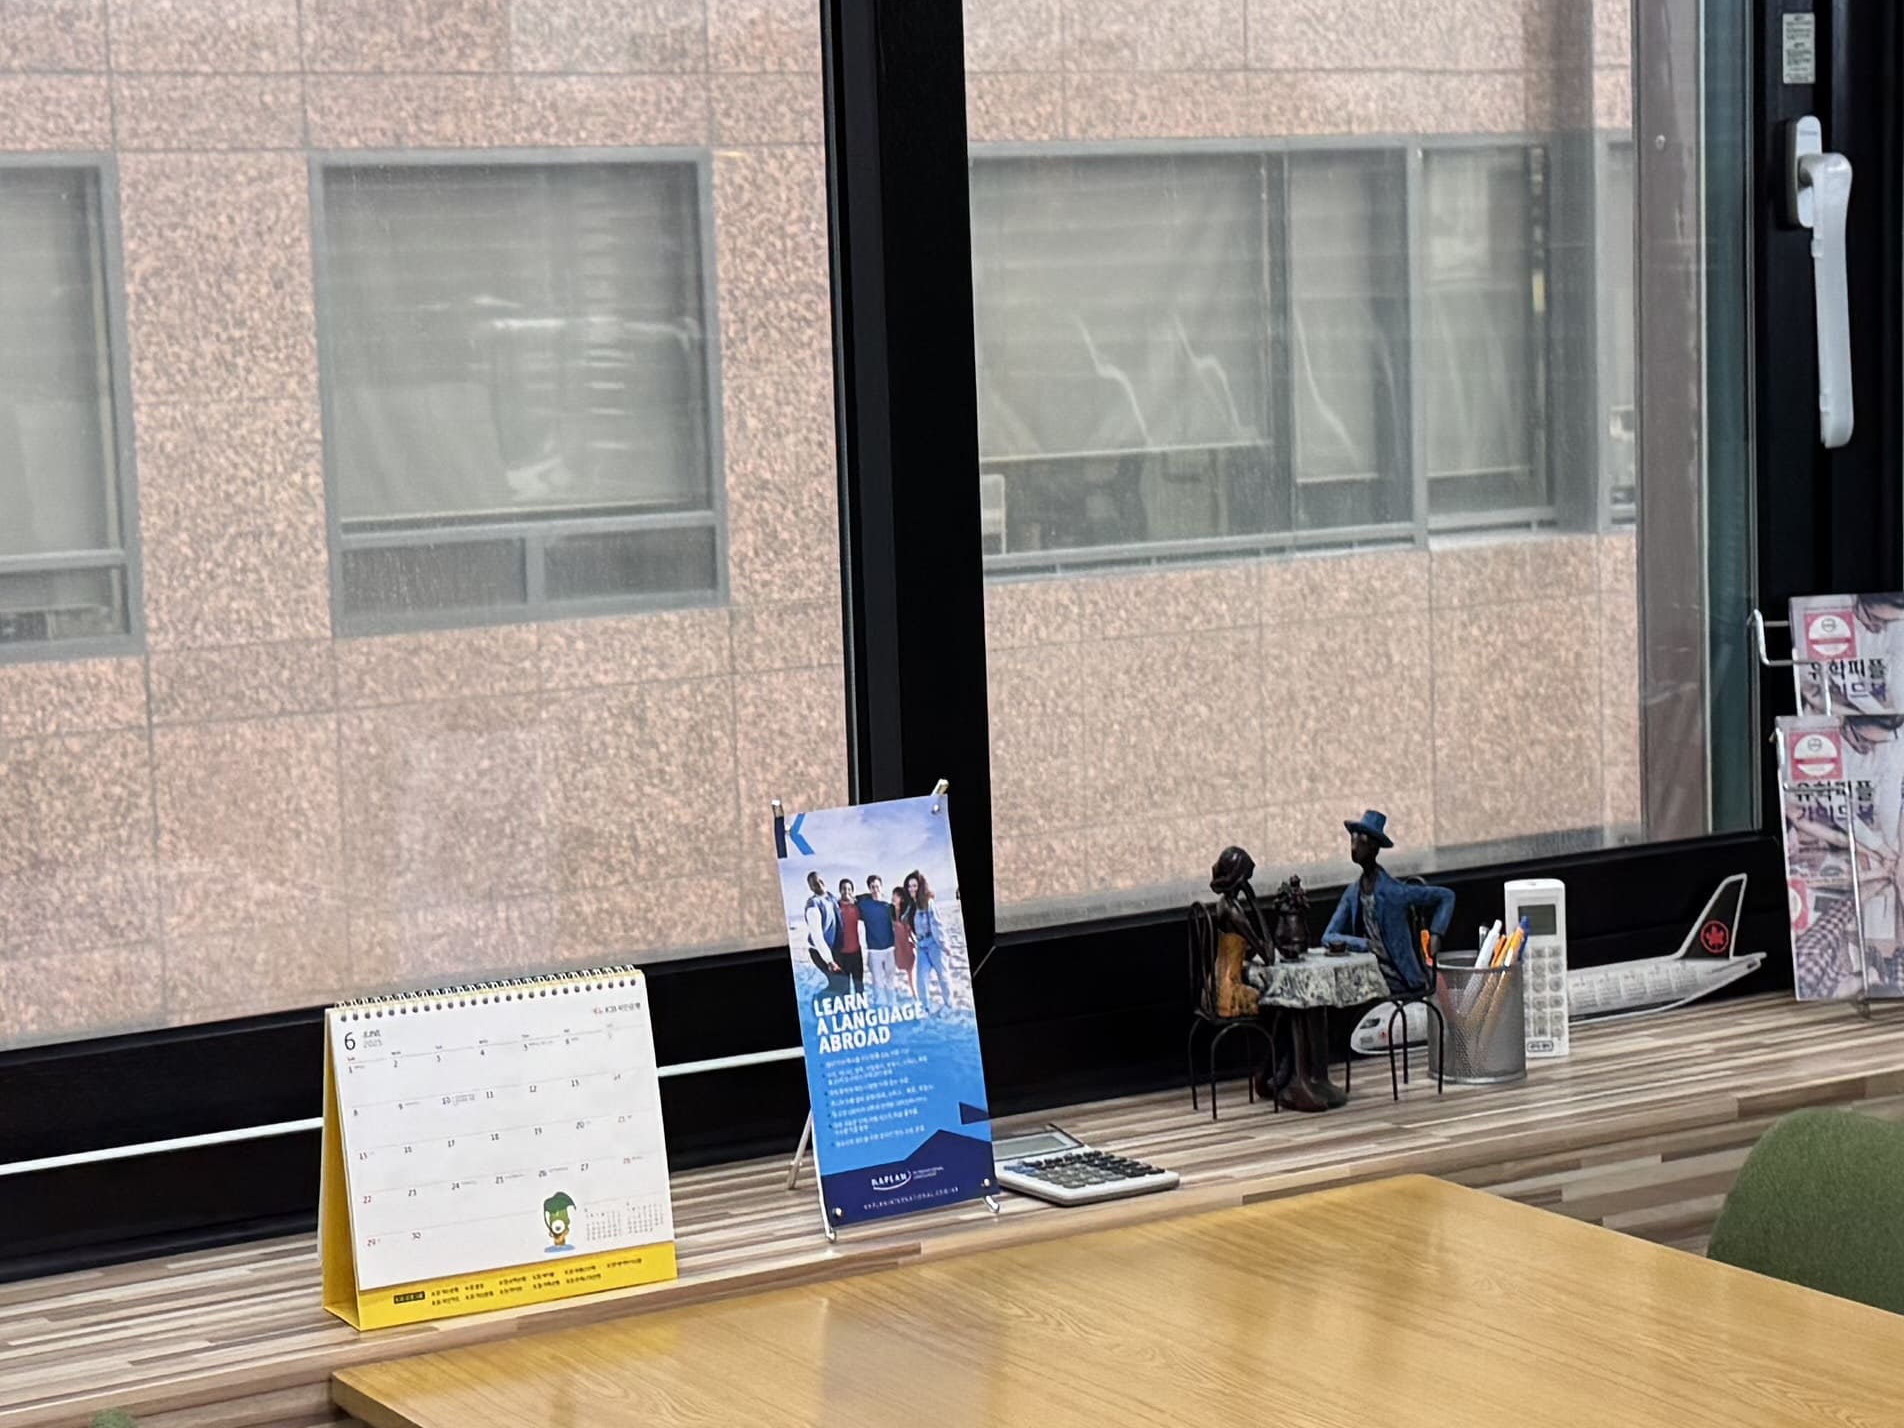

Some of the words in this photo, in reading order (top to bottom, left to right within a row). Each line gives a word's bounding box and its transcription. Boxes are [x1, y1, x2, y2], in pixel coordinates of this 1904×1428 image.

[814, 992, 869, 1017] LEARN
[817, 1017, 829, 1036] A
[831, 1001, 928, 1033] LANGUAGE
[344, 1031, 356, 1051] 6
[819, 1025, 891, 1054] ABROAD
